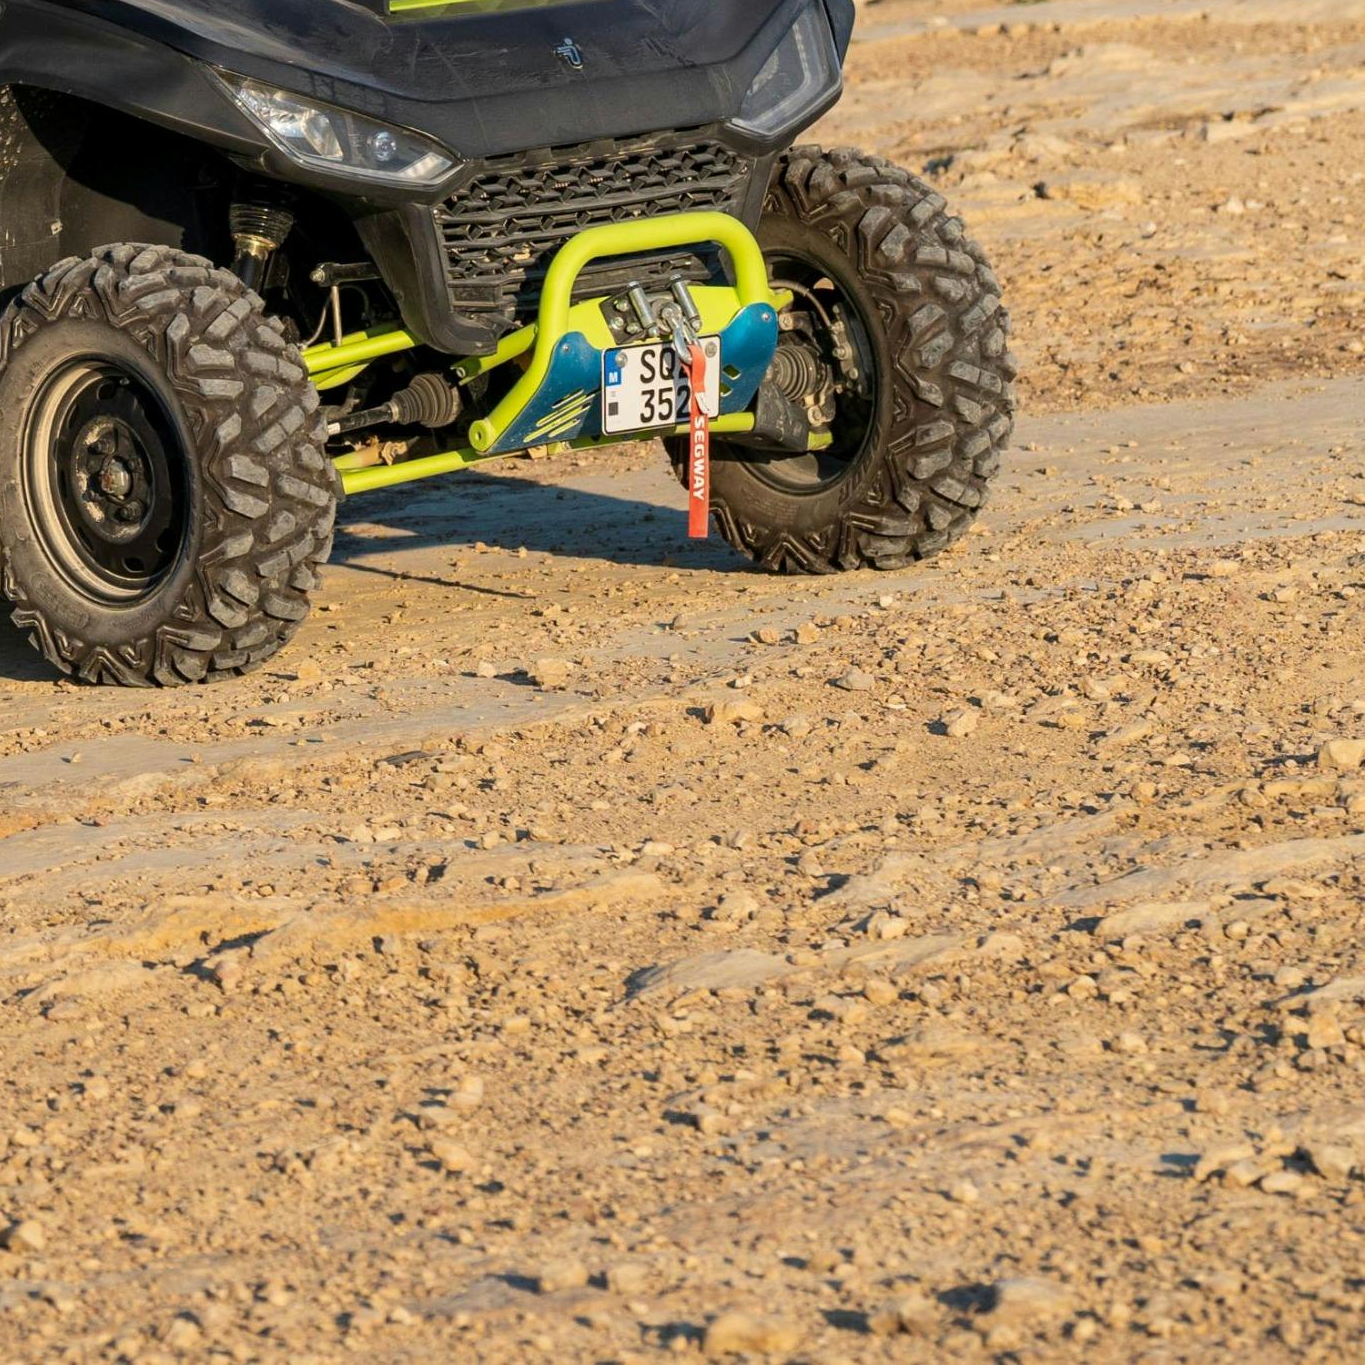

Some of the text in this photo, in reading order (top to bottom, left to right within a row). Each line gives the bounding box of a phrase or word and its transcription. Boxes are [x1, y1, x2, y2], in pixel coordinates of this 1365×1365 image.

[609, 371, 618, 383] M
[640, 386, 691, 423] 352
[693, 416, 705, 500] SEGWAY
